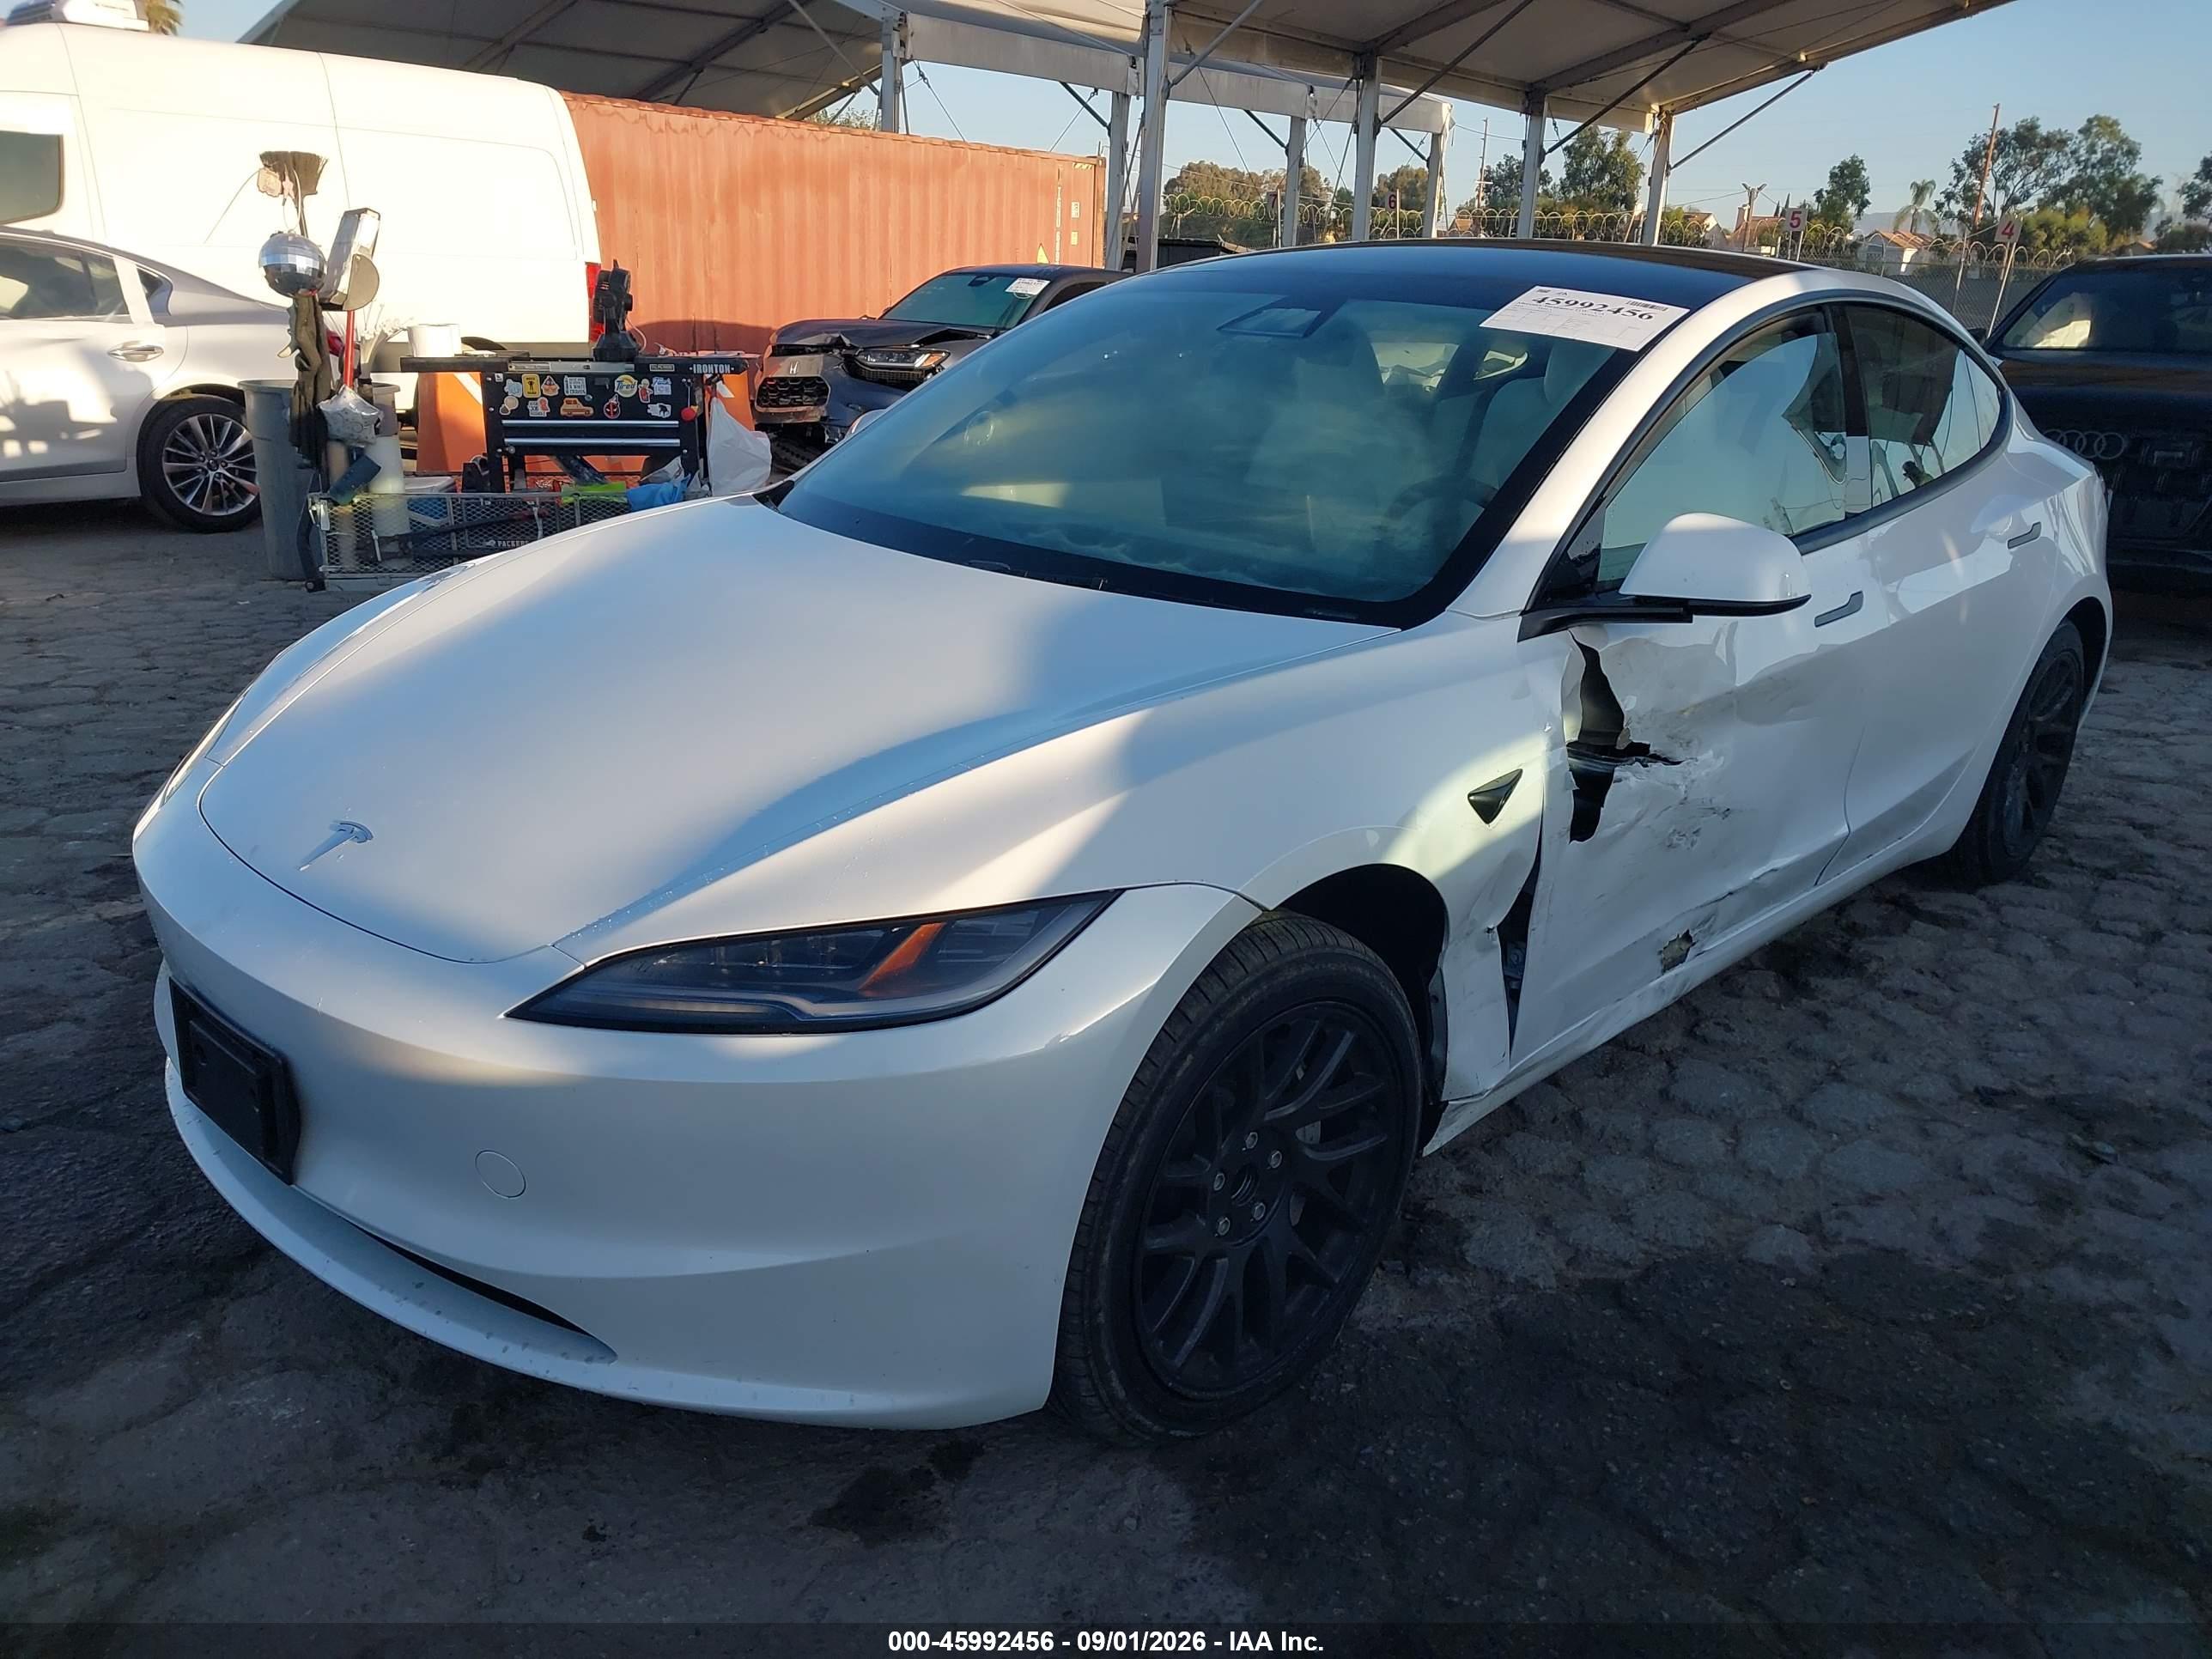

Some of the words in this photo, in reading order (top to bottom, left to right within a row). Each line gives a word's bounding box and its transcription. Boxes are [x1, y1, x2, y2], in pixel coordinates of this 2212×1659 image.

[1268, 193, 1278, 209] 7
[1388, 193, 1397, 210] 6
[1789, 210, 1802, 229] 5
[2001, 220, 2014, 240] 4
[1532, 296, 1654, 320] 45992456
[692, 363, 732, 374] IRONTON
[616, 380, 636, 391] Tired
